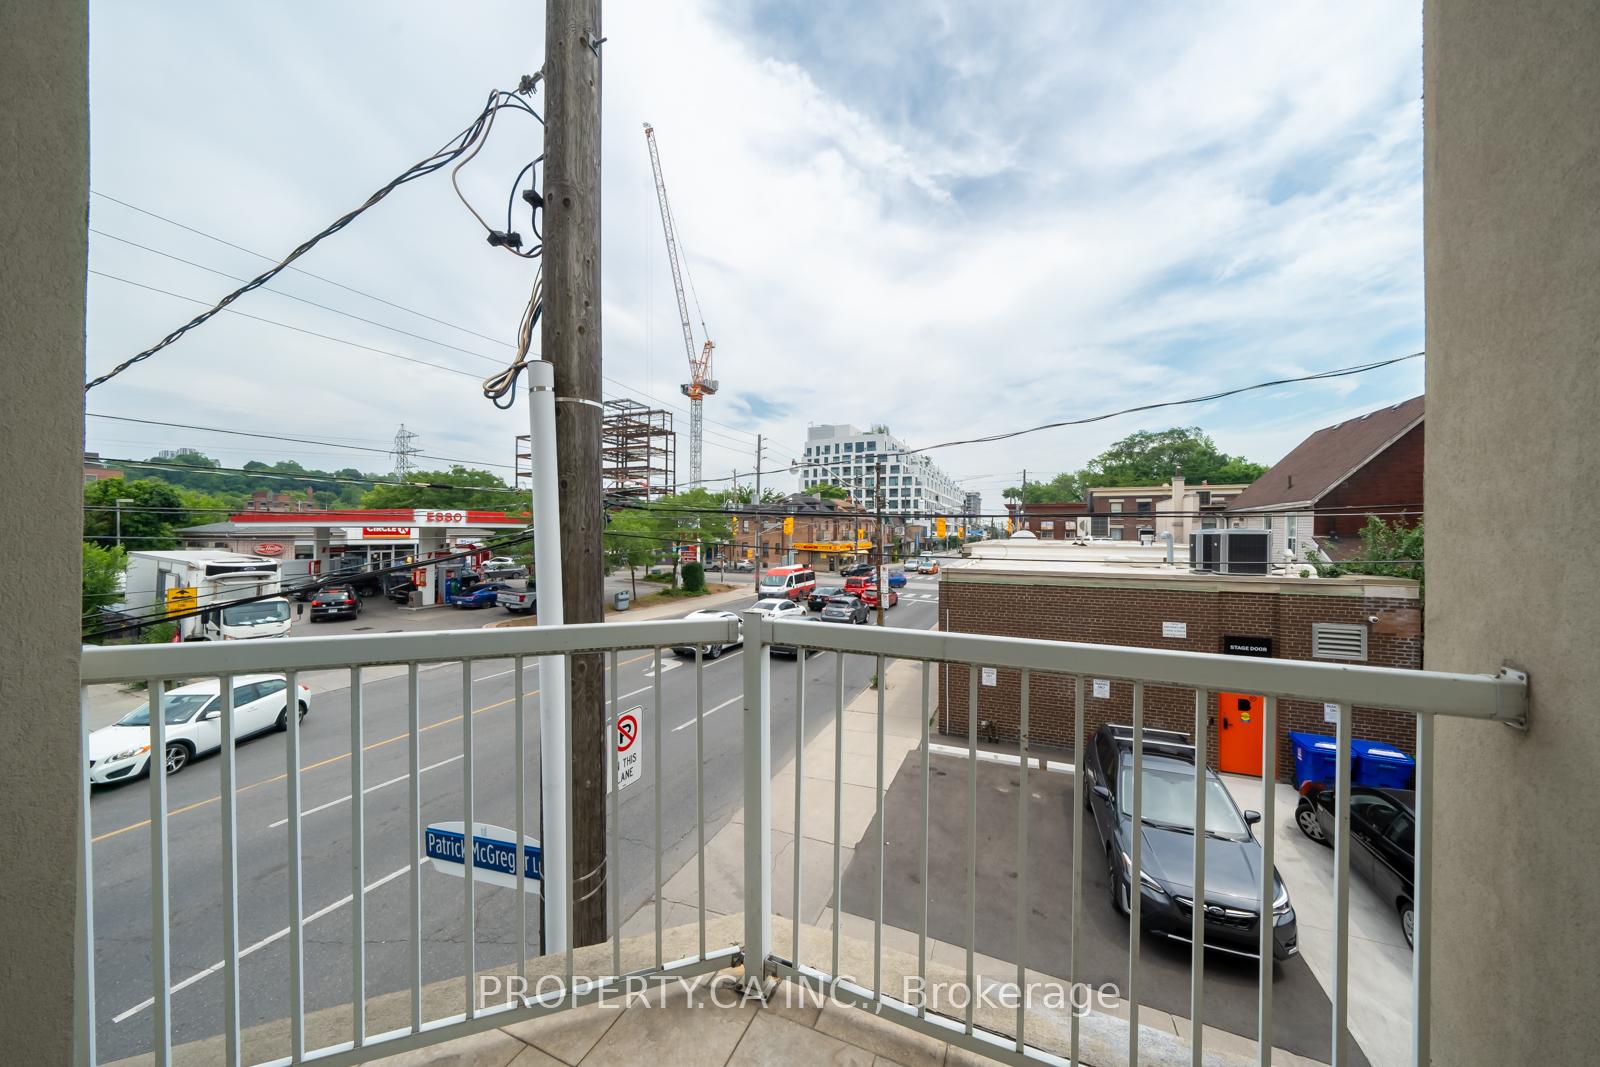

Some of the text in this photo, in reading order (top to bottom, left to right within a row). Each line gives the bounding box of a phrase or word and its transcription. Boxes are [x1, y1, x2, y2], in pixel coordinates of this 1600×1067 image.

[426, 512, 462, 522] ESSO
[622, 752, 637, 768] THIS
[617, 767, 634, 784] ANE
[428, 833, 466, 859] Patrick
[472, 842, 529, 874] McGregr
